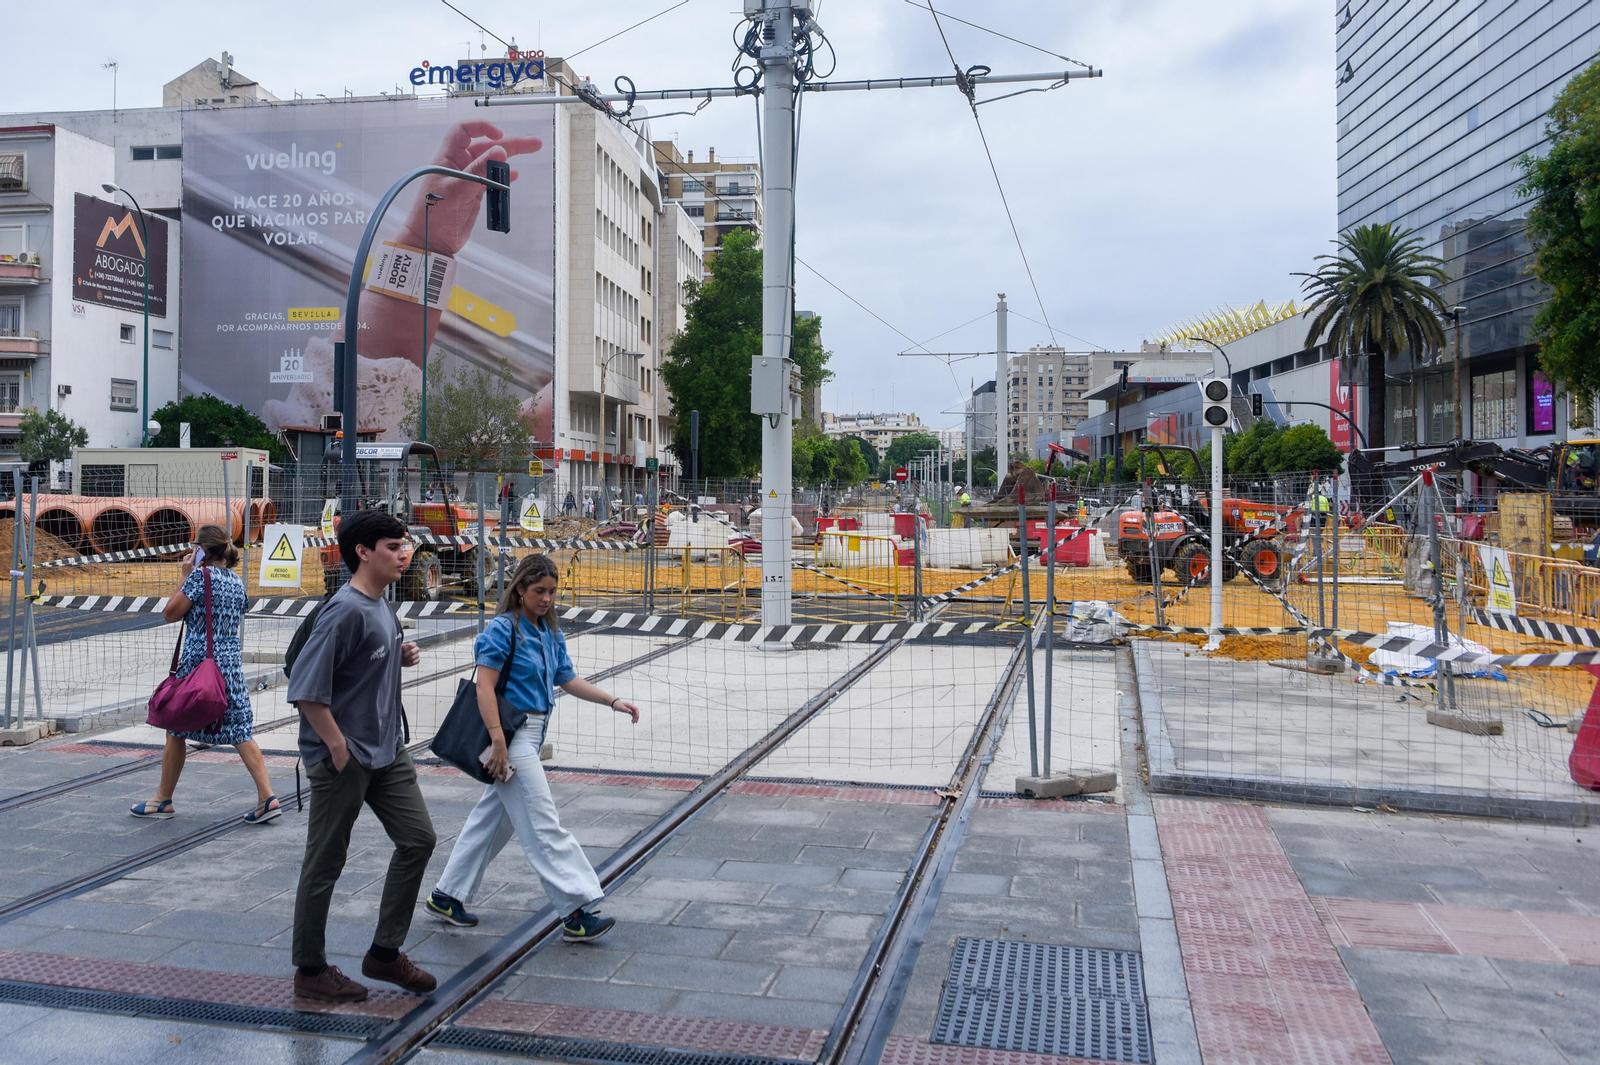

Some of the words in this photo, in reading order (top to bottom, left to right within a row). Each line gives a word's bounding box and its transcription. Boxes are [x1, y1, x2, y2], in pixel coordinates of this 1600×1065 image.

[509, 49, 545, 61] grupo
[409, 60, 544, 88] emergya
[246, 143, 336, 175] vueling
[234, 194, 277, 210] HACE
[282, 193, 302, 208] 20
[307, 189, 355, 207] AÑOS
[211, 214, 246, 232] QUE
[251, 212, 329, 228] NACIMOS
[263, 231, 324, 246] VOLAR.
[95, 253, 145, 278] ABOGADO
[376, 253, 389, 280] vueling
[388, 254, 403, 285] BORN
[401, 254, 412, 274] FLY
[396, 275, 407, 289] TO
[244, 312, 286, 321] GRACIAS,
[292, 310, 337, 319] SEVILLA.
[216, 324, 235, 332] POR
[236, 321, 311, 332] ACOMPAÑARNOS
[313, 321, 342, 331] DESDE
[284, 359, 299, 371] 20
